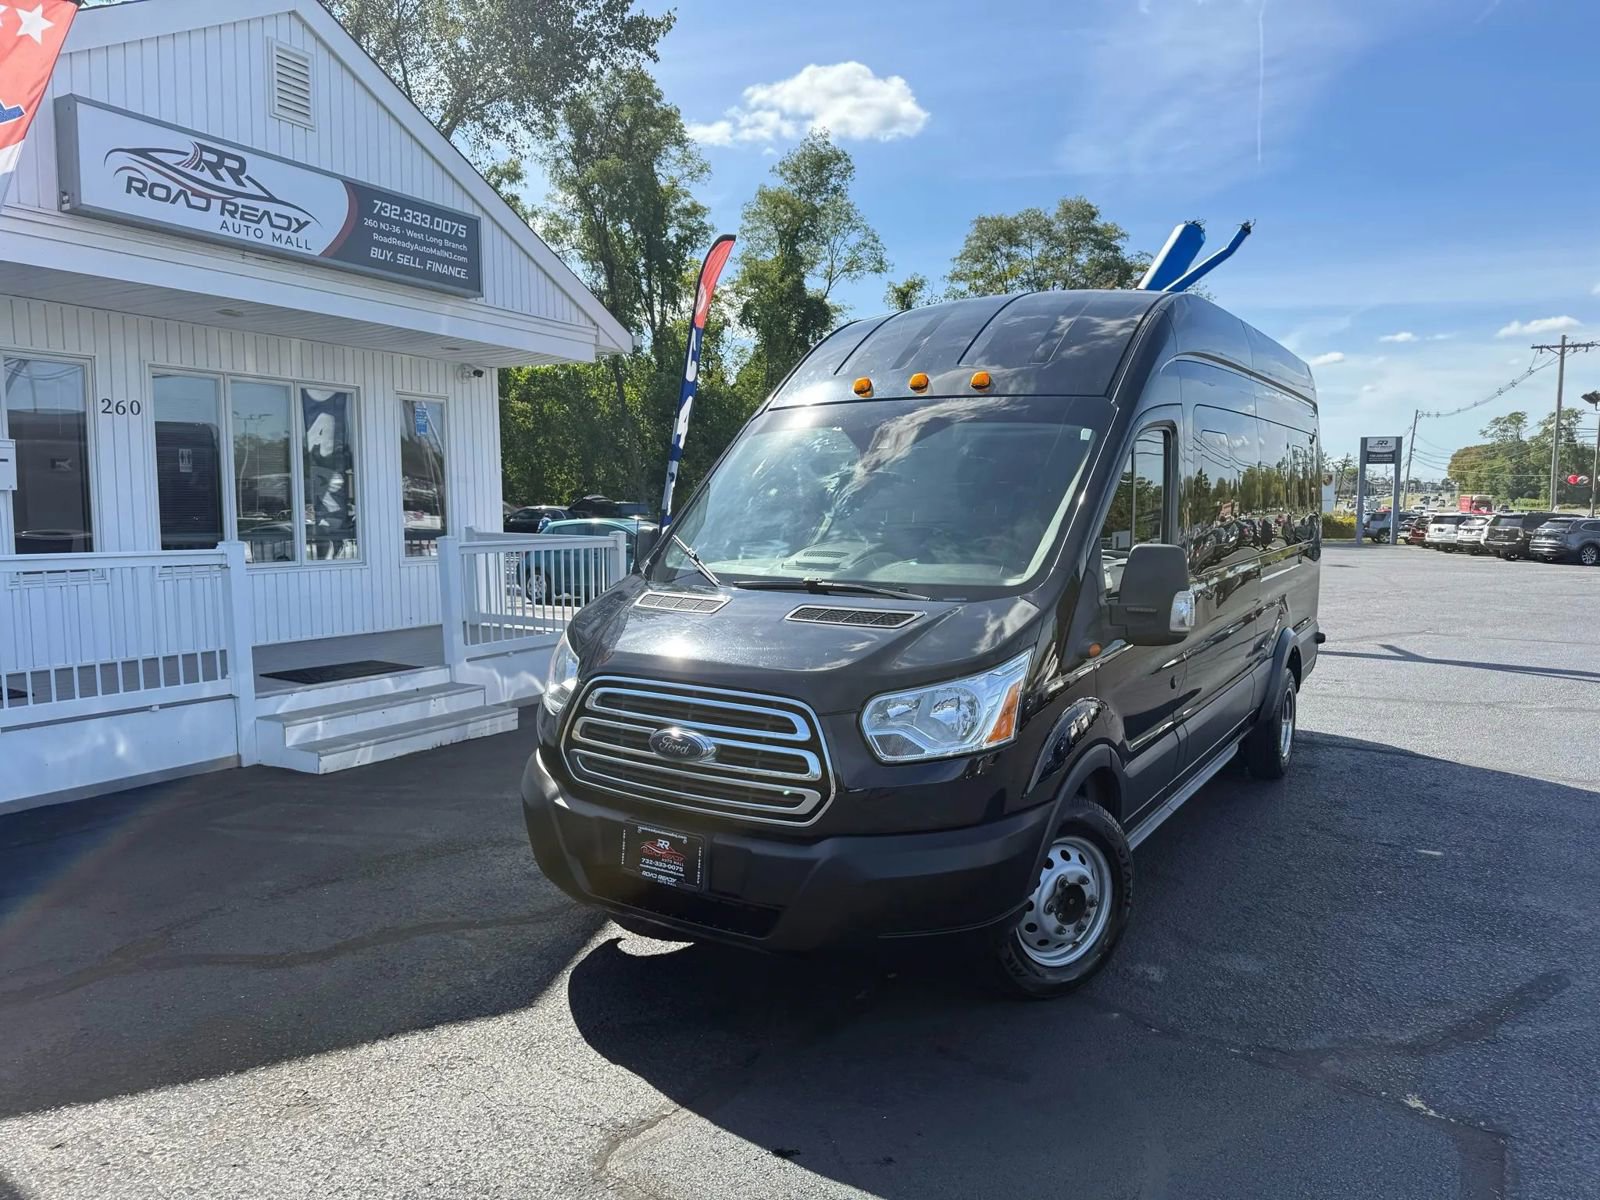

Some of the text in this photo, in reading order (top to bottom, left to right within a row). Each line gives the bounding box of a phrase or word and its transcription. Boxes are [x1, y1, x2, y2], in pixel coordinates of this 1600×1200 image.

[125, 175, 312, 234] ROAD READY
[373, 199, 467, 238] 732.333.0075
[219, 220, 313, 251] AUTO MALL
[363, 217, 468, 252] 260 NJ-36 West Long Branch
[370, 247, 469, 280] BUY. SELL. FINANCE.
[101, 398, 141, 416] 260
[659, 735, 691, 756] Ford
[641, 857, 684, 872] 732-333-0075
